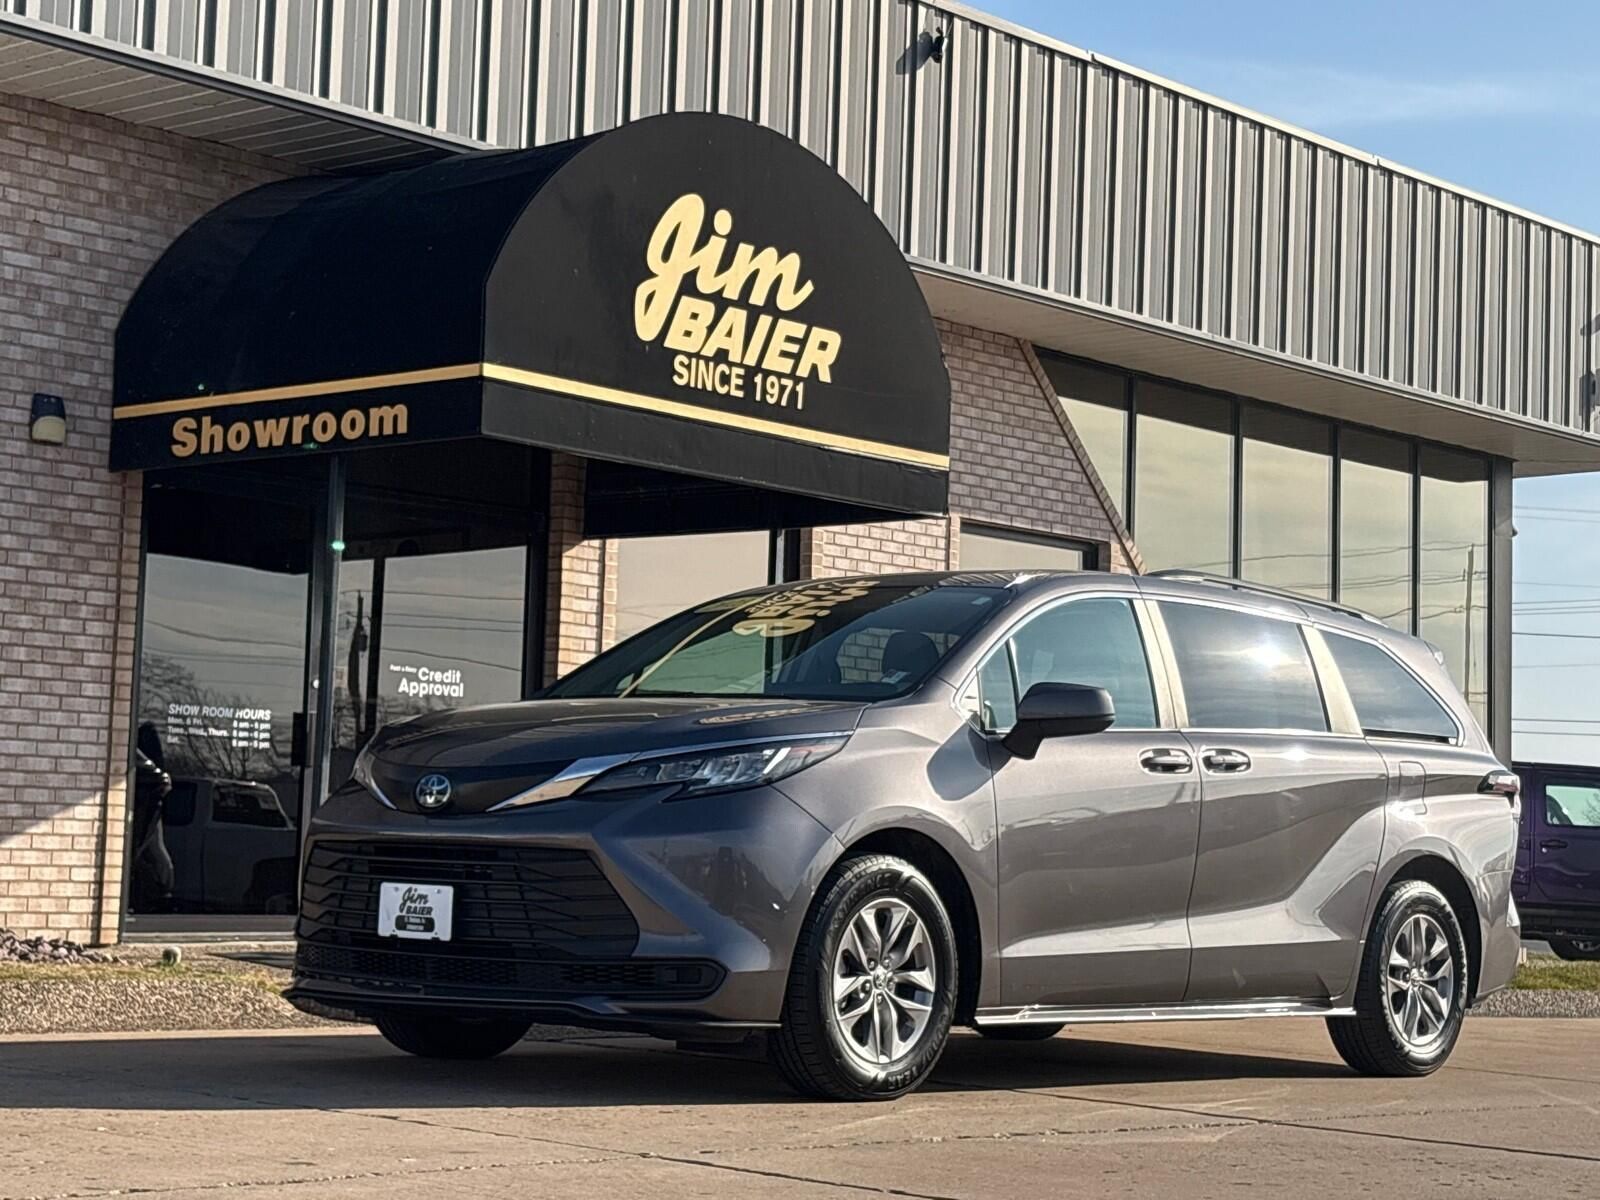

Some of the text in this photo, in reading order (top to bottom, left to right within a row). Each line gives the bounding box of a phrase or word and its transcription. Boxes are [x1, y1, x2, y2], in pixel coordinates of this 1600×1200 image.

[634, 193, 815, 342] Jim
[663, 295, 842, 384] BAIER
[672, 354, 805, 410] SINCE 1971
[171, 403, 408, 458] Showroom
[398, 677, 464, 698] Approval
[418, 667, 461, 684] Credit
[168, 703, 272, 721] SHOW ROOM HOURS
[399, 886, 429, 914] Jim
[405, 905, 433, 916] BAIER
